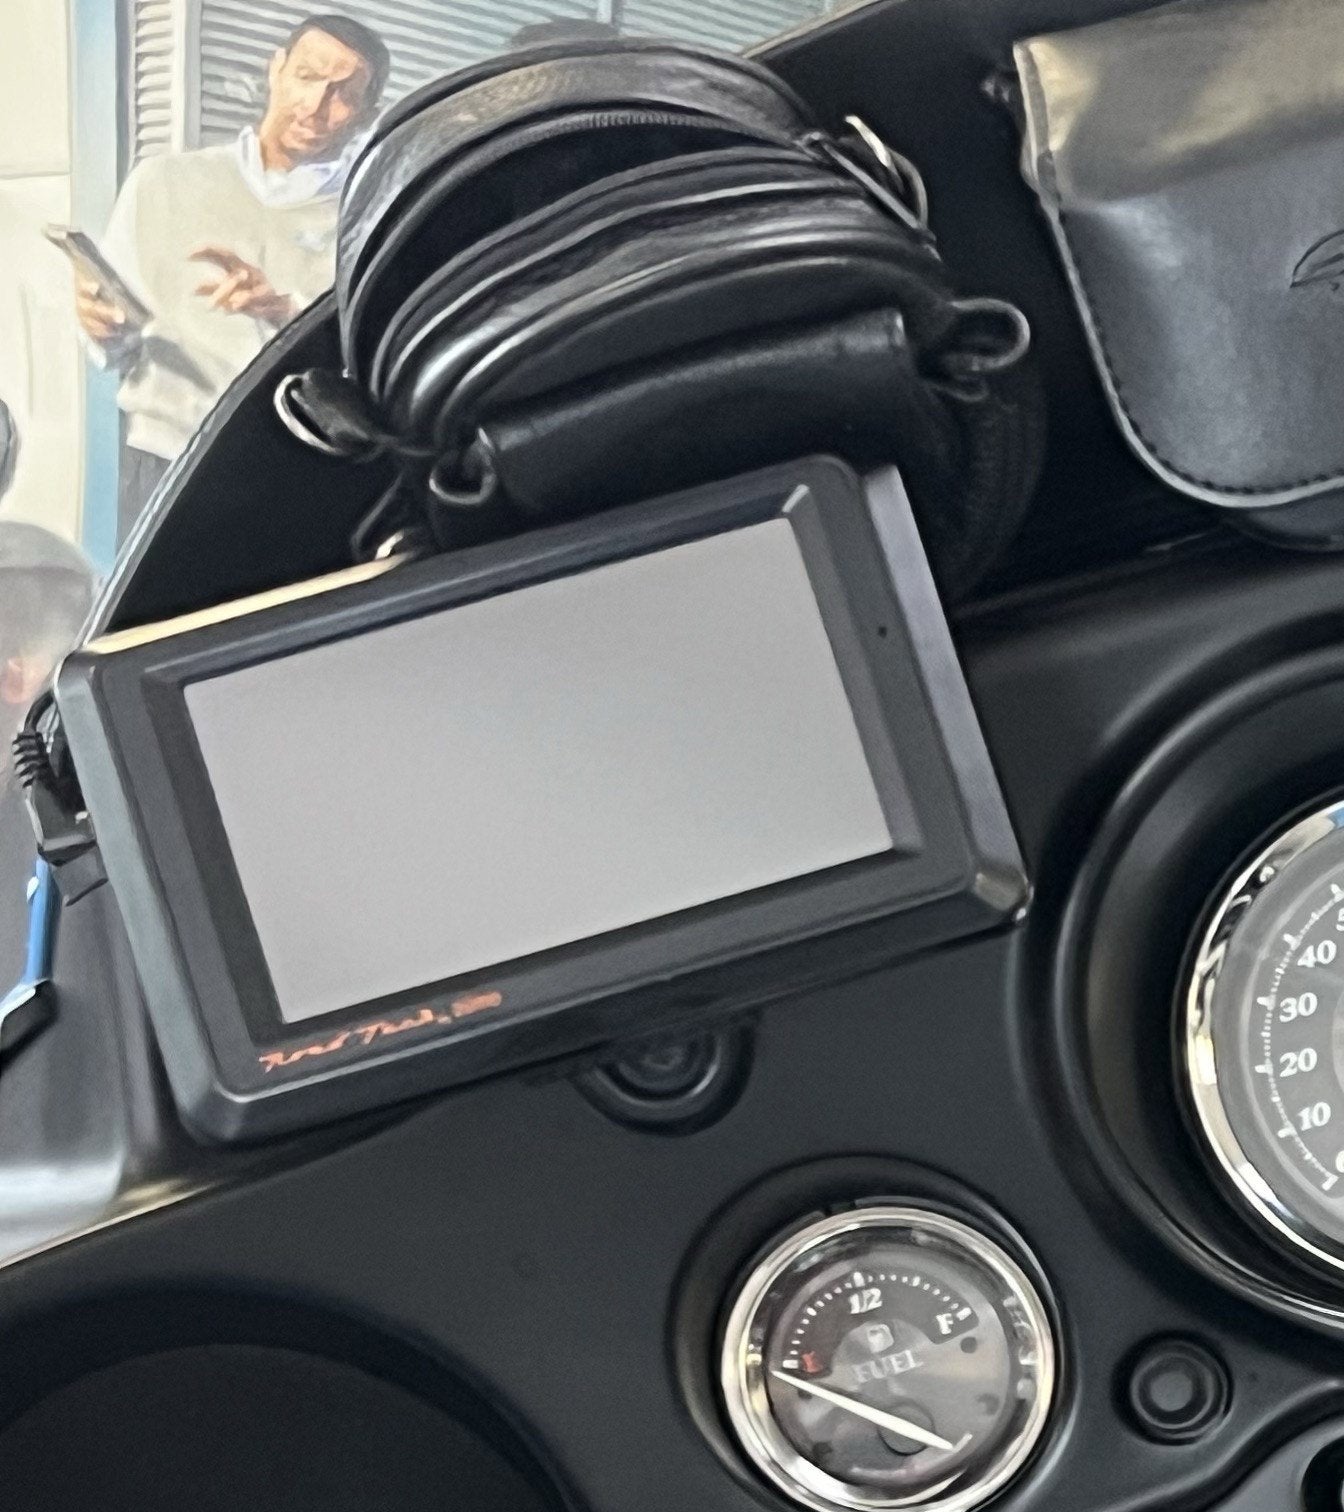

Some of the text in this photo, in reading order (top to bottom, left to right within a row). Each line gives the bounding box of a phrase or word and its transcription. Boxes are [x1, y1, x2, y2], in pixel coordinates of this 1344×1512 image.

[1298, 940, 1337, 969] 40
[1279, 992, 1318, 1023] 30
[1279, 1047, 1318, 1077] 20
[1298, 1102, 1331, 1131] 10
[936, 1312, 954, 1335] F
[852, 1350, 923, 1384] FUEL
